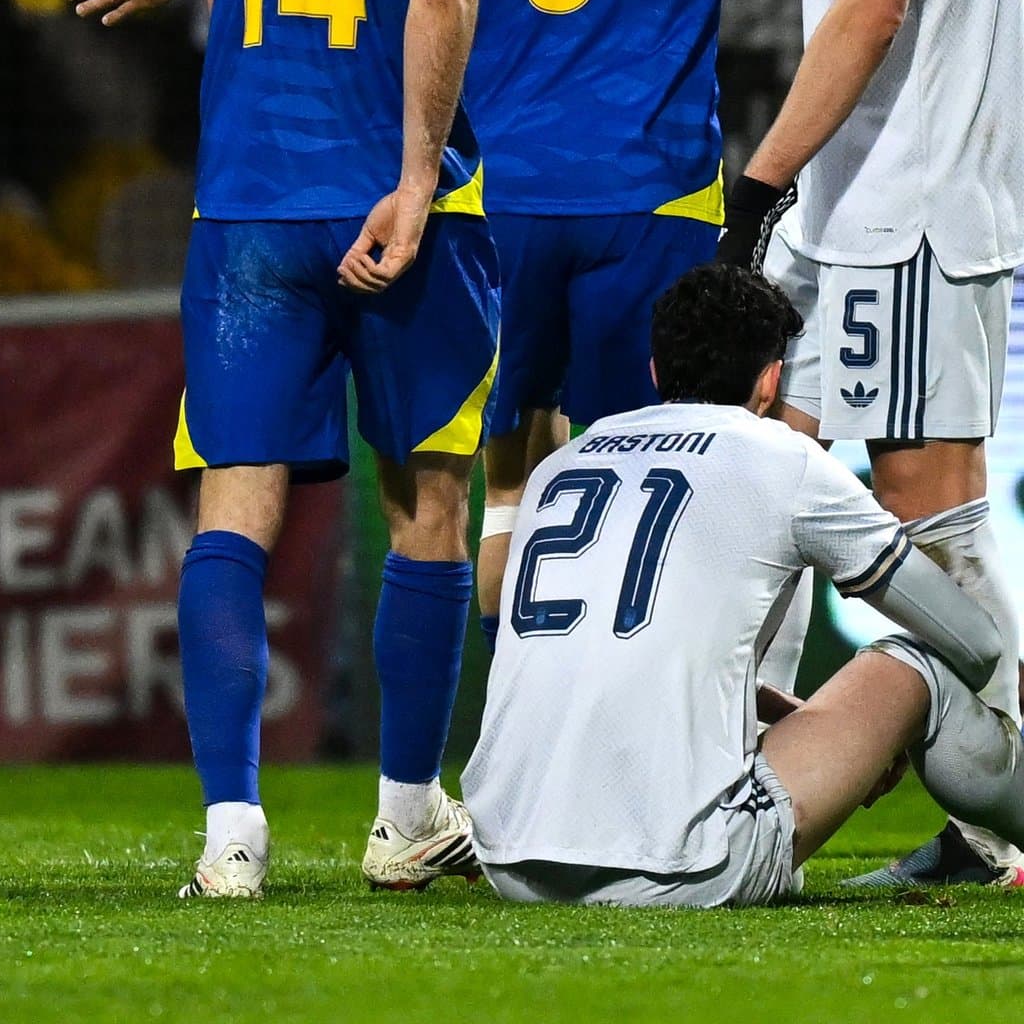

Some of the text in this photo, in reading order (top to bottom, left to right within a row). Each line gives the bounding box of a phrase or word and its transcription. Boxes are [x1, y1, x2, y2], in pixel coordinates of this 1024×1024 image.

[840, 288, 881, 369] 5
[578, 432, 717, 456] BASTONI
[511, 467, 695, 639] 21
